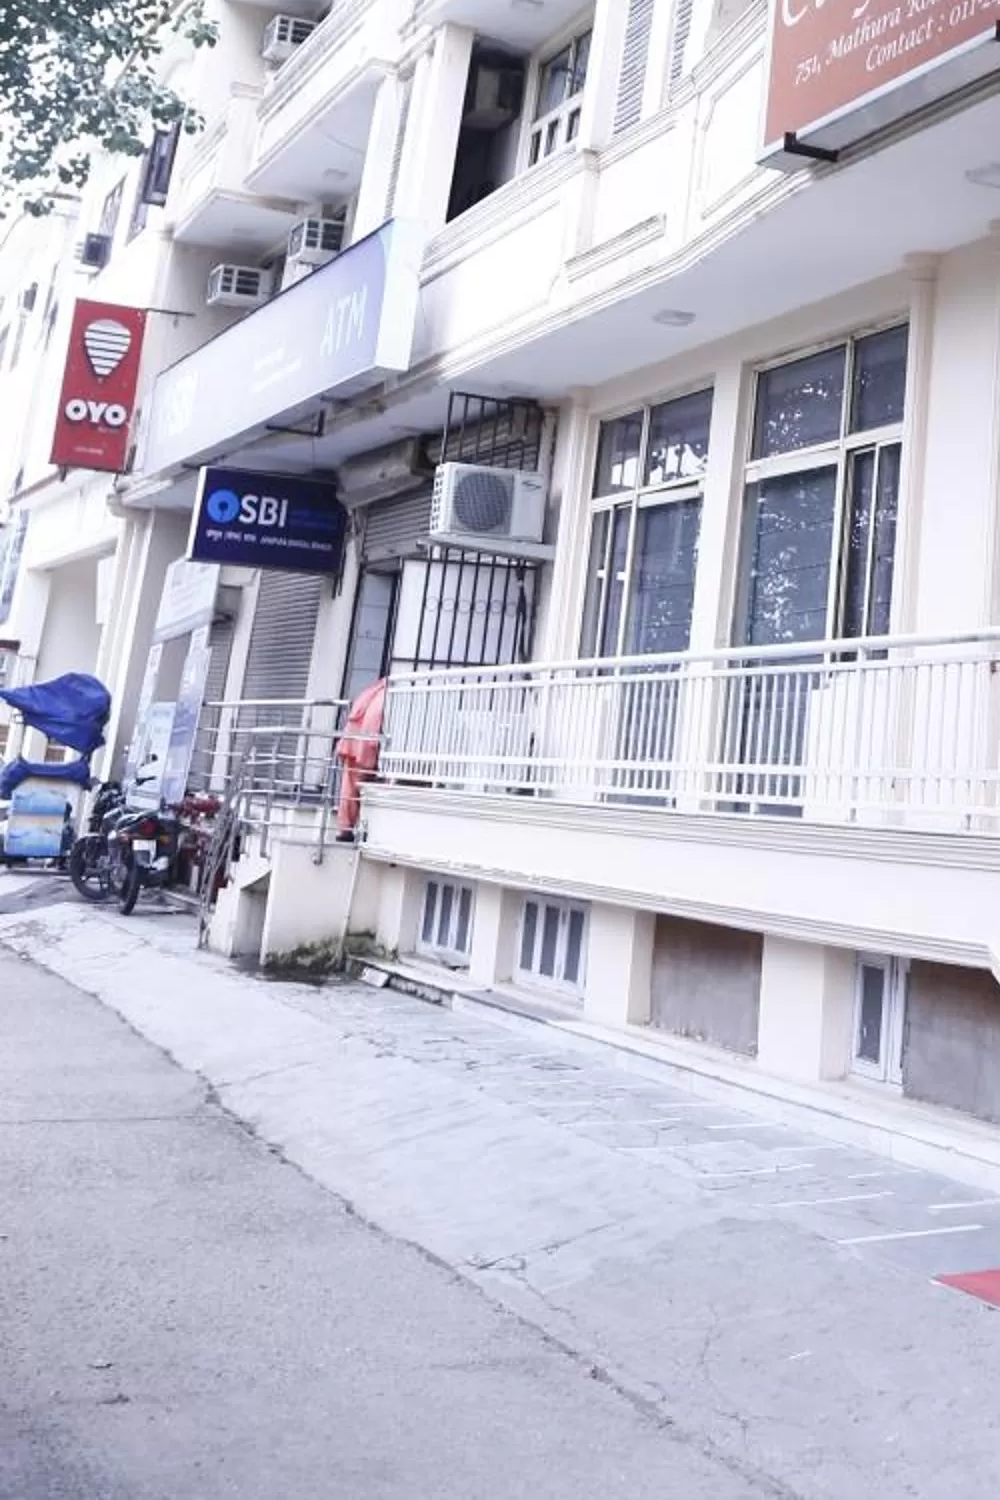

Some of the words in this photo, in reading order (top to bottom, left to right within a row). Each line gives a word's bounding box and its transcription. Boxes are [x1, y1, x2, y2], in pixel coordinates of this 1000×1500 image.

[825, 7, 902, 66] Mathura
[865, 15, 935, 72] Contact
[320, 283, 368, 357] ATM
[65, 398, 127, 426] OYO
[238, 493, 288, 528] SBI
